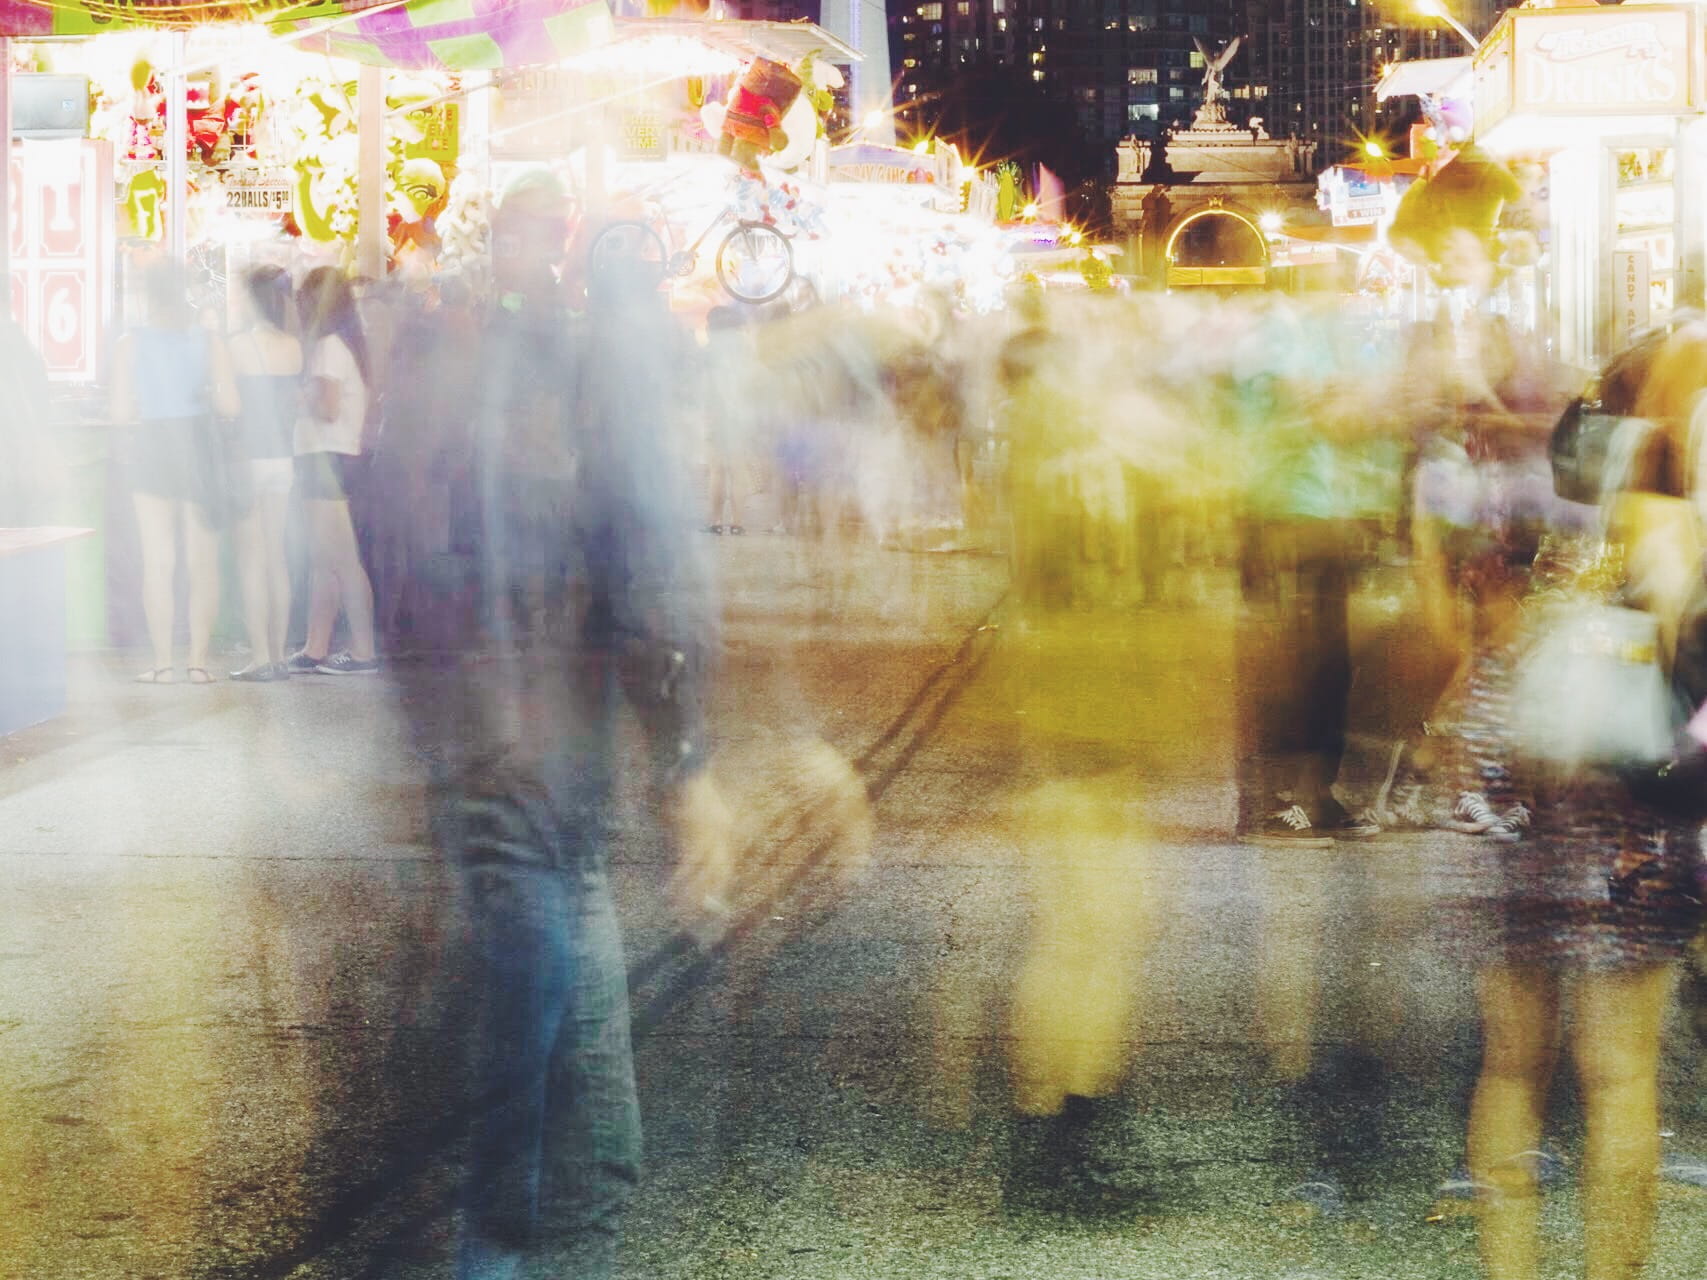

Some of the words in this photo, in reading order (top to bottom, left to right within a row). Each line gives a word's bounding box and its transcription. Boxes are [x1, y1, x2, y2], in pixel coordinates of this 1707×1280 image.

[1525, 52, 1677, 104] DRINKS
[1626, 255, 1636, 302] CANDY
[48, 286, 77, 344] 6
